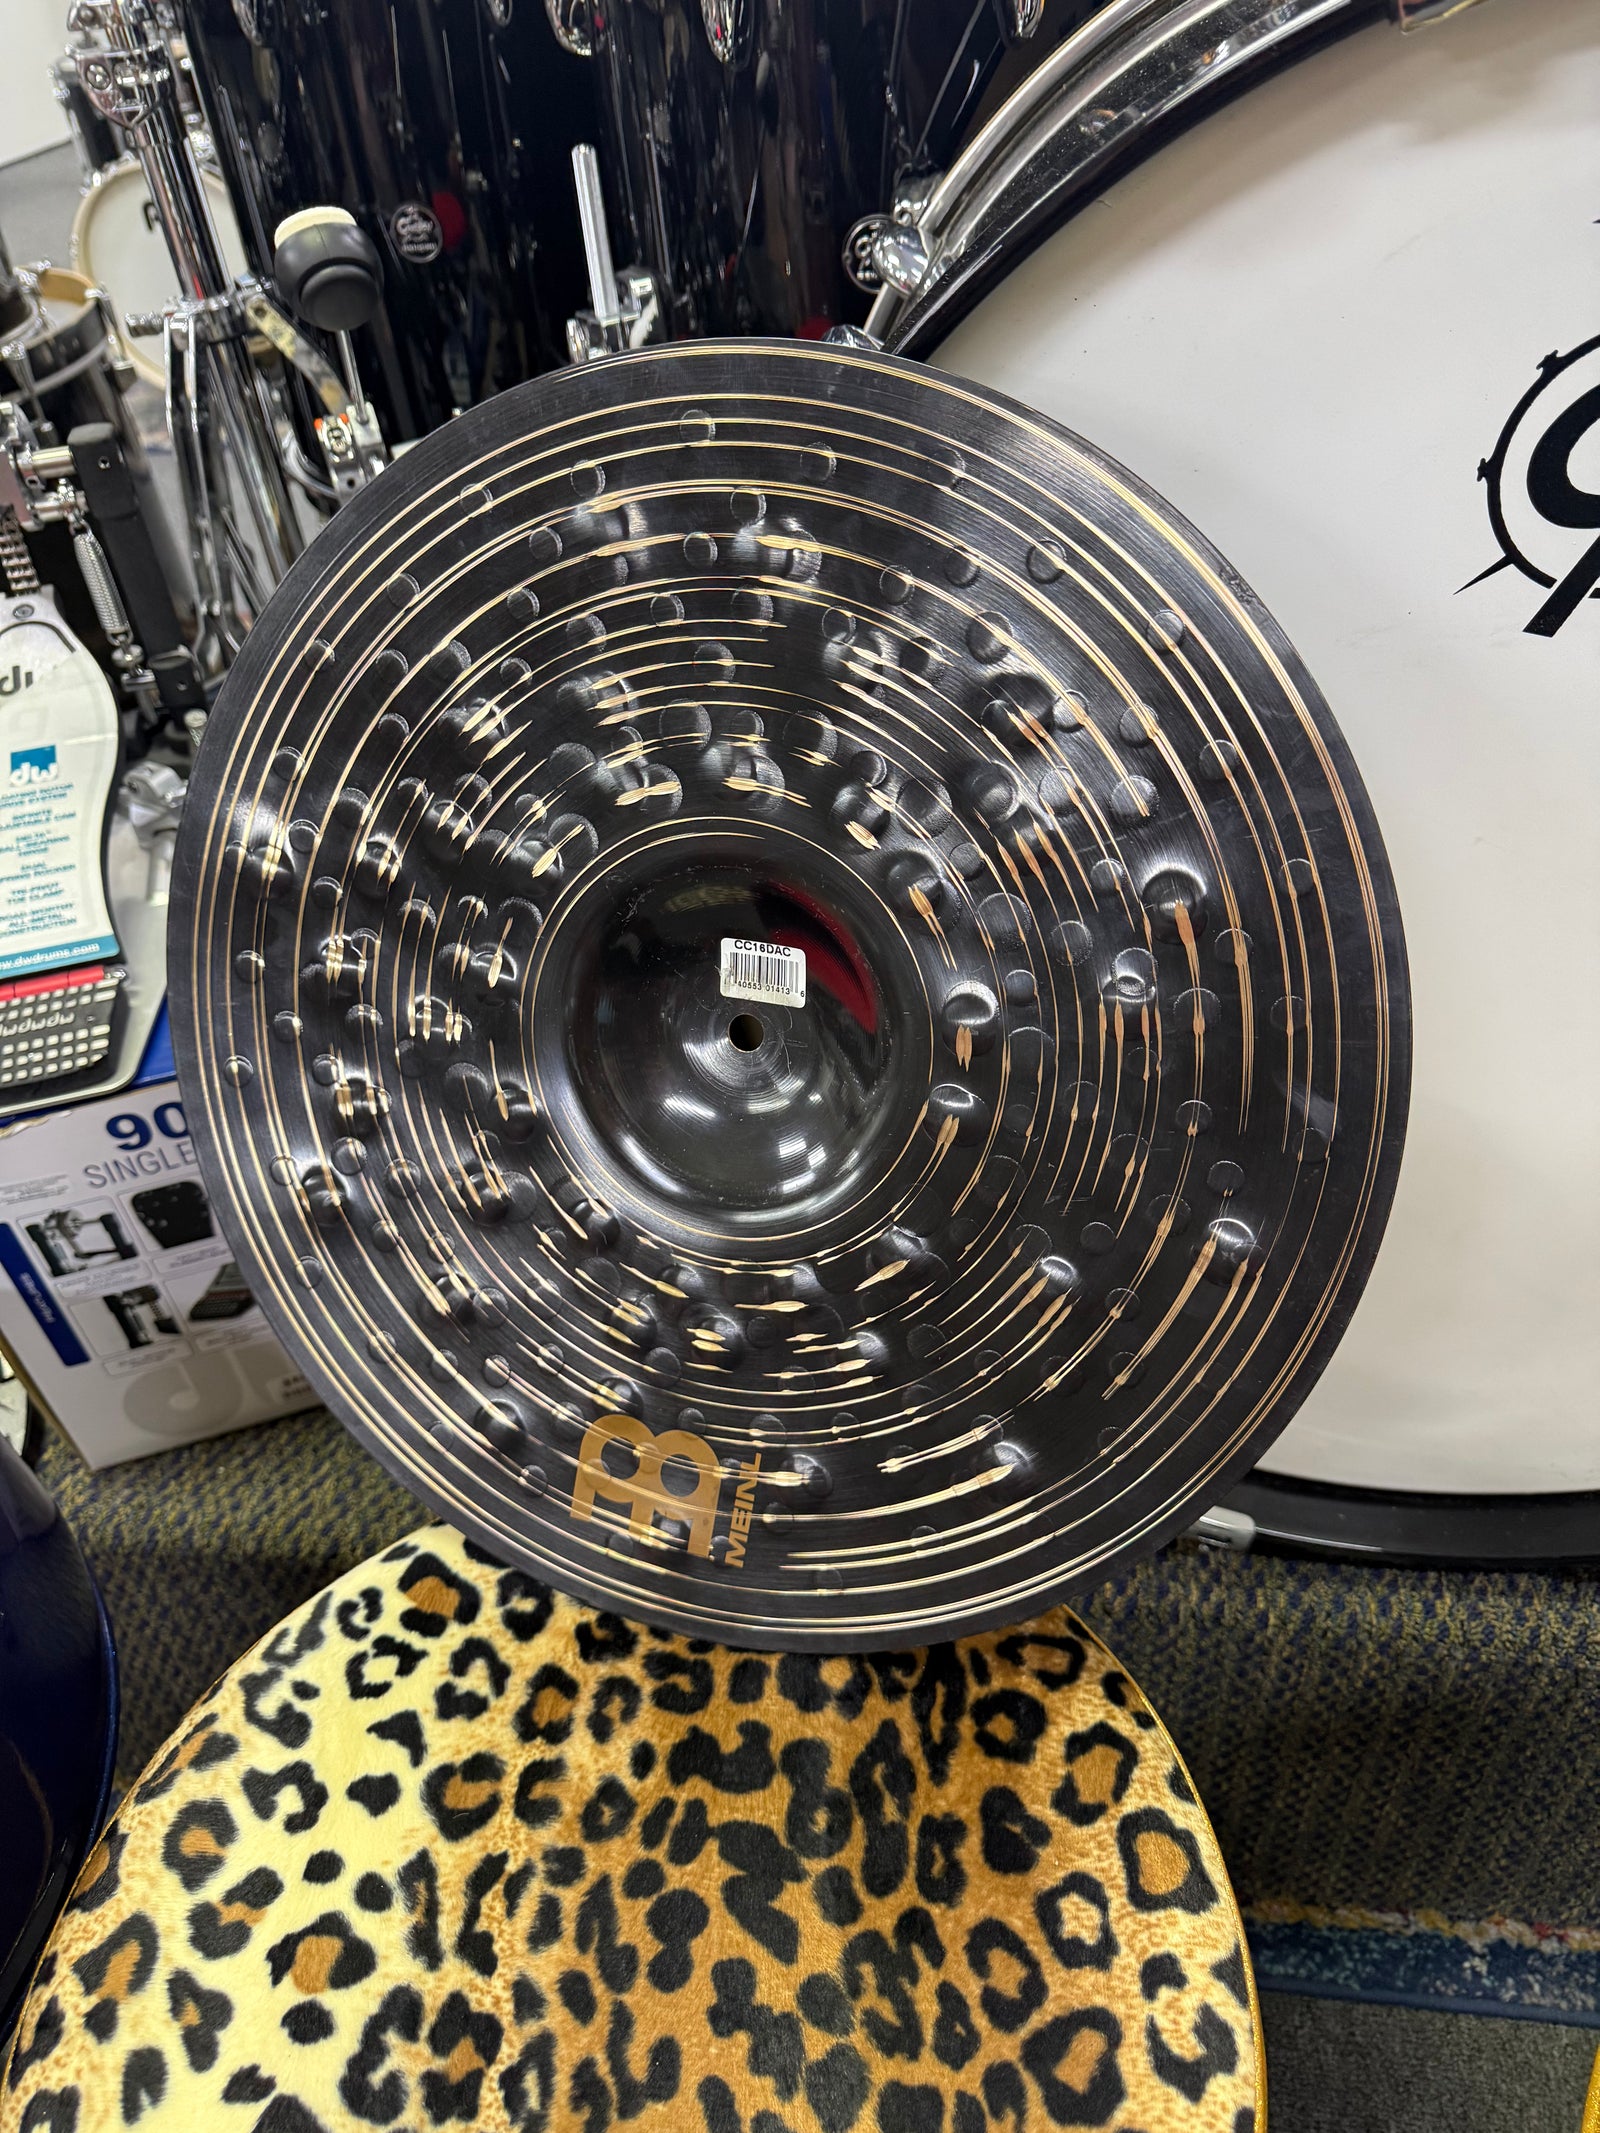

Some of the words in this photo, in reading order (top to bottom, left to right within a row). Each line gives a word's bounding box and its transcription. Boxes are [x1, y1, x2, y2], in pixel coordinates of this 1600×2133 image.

[10, 761, 58, 787] dw
[0, 943, 100, 969] w.dwdrums.com
[734, 940, 791, 957] CC16DAC
[765, 984, 791, 995] 01413
[800, 990, 805, 998] 6
[84, 1140, 199, 1189] SINGLE
[725, 1452, 762, 1568] MEINL
